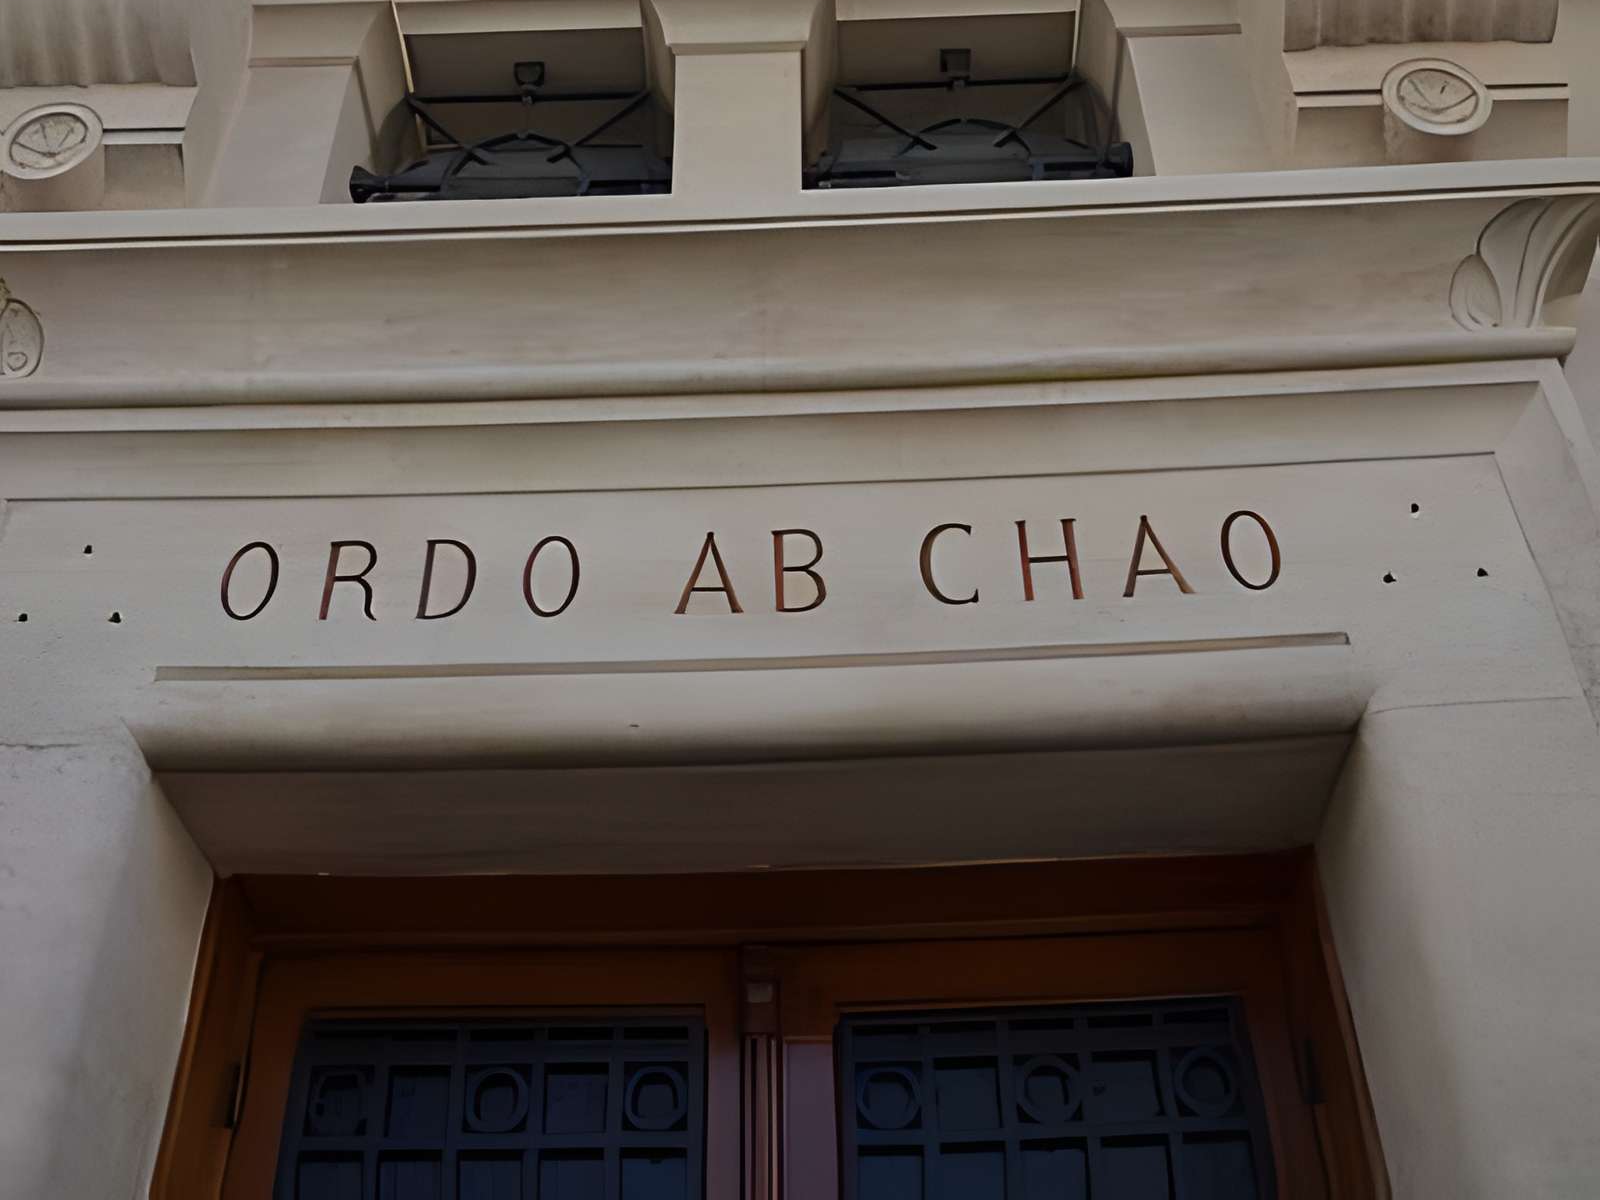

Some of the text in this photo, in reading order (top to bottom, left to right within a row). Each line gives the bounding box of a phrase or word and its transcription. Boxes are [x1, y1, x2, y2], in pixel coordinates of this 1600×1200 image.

[220, 509, 1282, 622] ORDO AB CHAO
